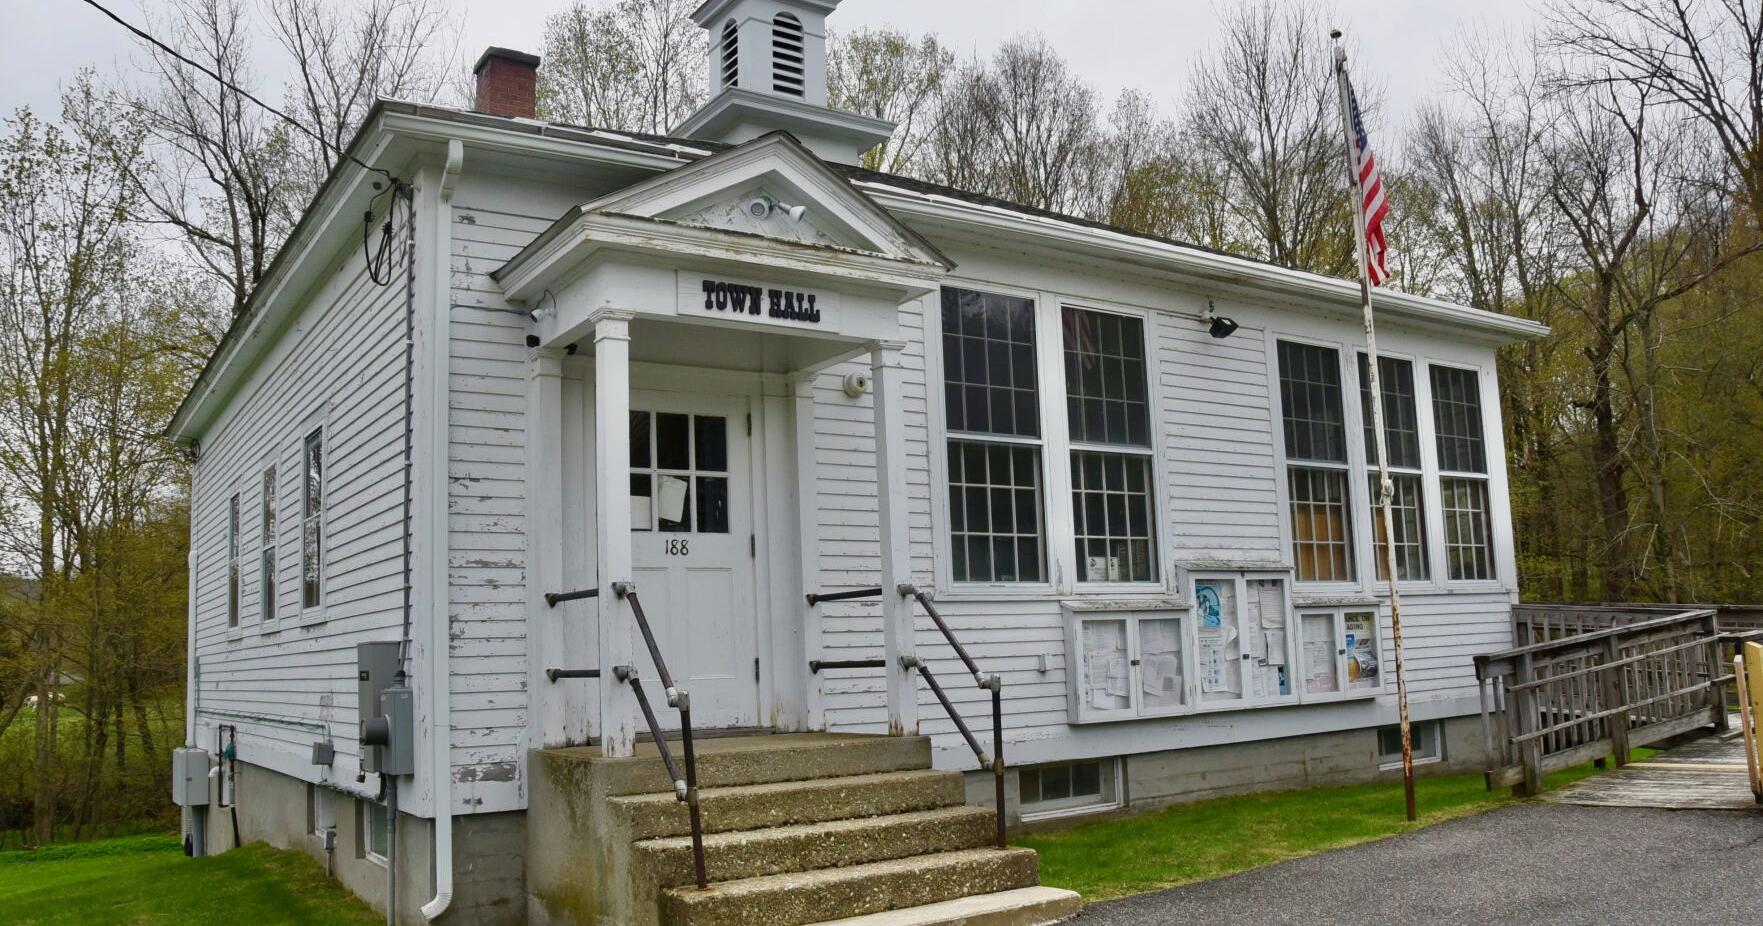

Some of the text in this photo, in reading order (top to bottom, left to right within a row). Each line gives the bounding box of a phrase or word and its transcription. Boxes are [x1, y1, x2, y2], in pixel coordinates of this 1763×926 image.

[702, 280, 820, 323] TOWN HALL
[665, 539, 689, 556] 188
